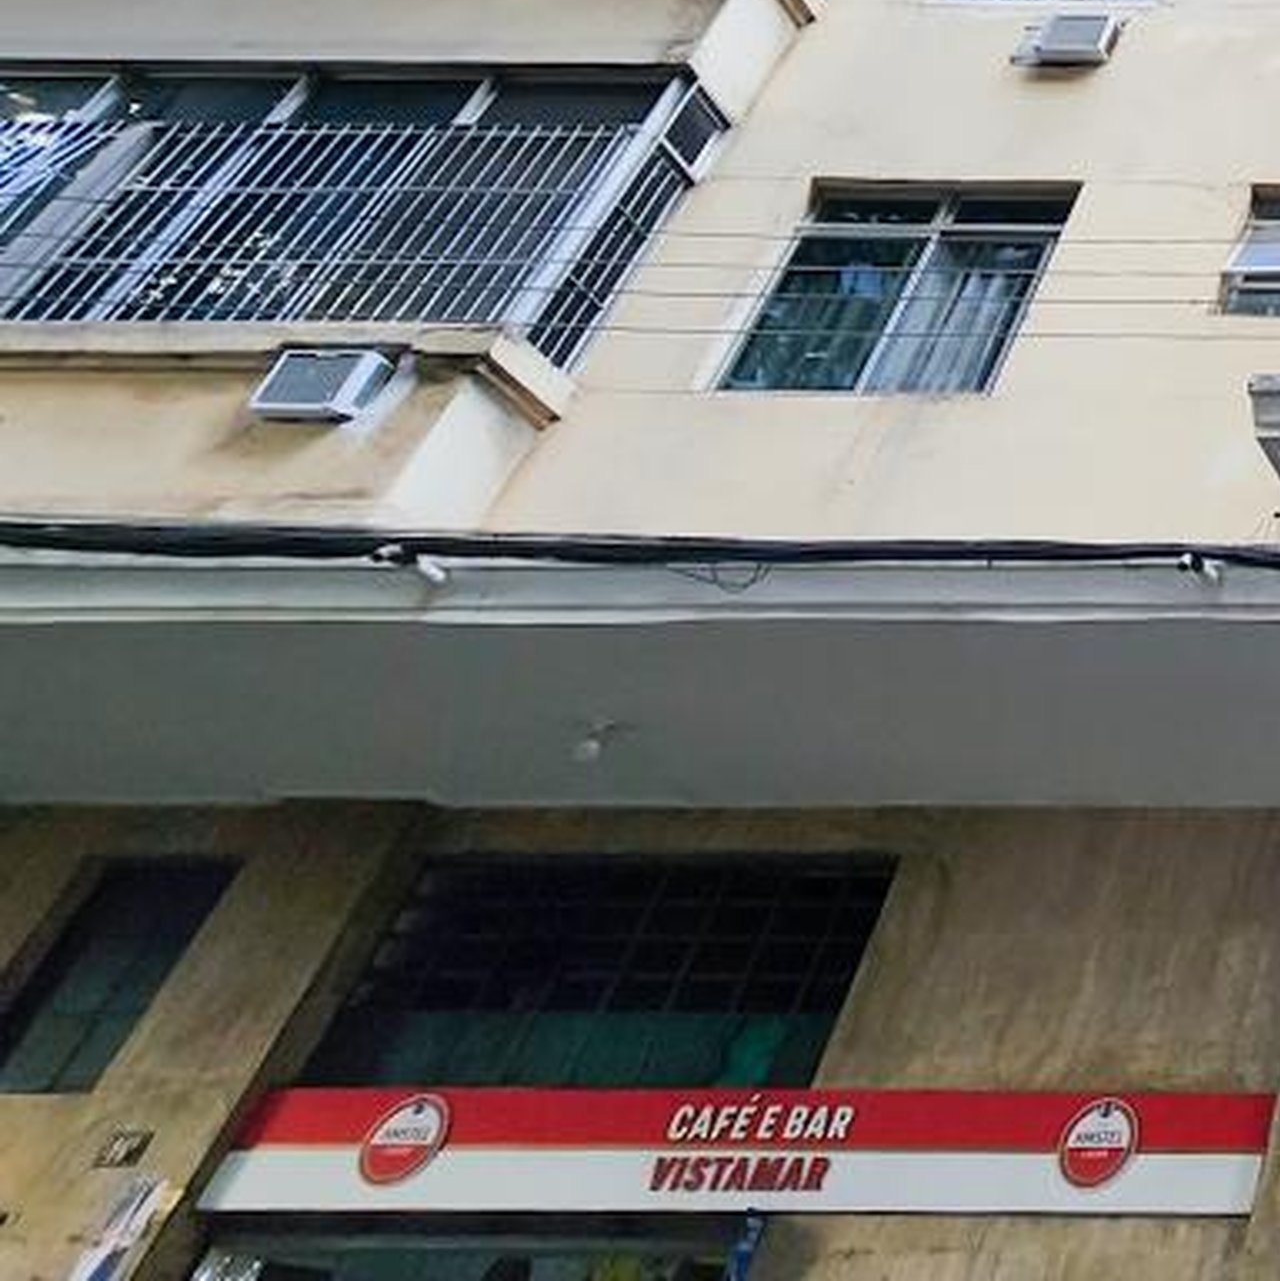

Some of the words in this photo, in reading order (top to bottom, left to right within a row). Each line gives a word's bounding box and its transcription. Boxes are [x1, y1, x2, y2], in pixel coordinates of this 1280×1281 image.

[667, 1093, 760, 1141] CAFÉ
[758, 1104, 782, 1140] E
[782, 1105, 855, 1140] BAR
[650, 1157, 831, 1192] VISTAMAR
